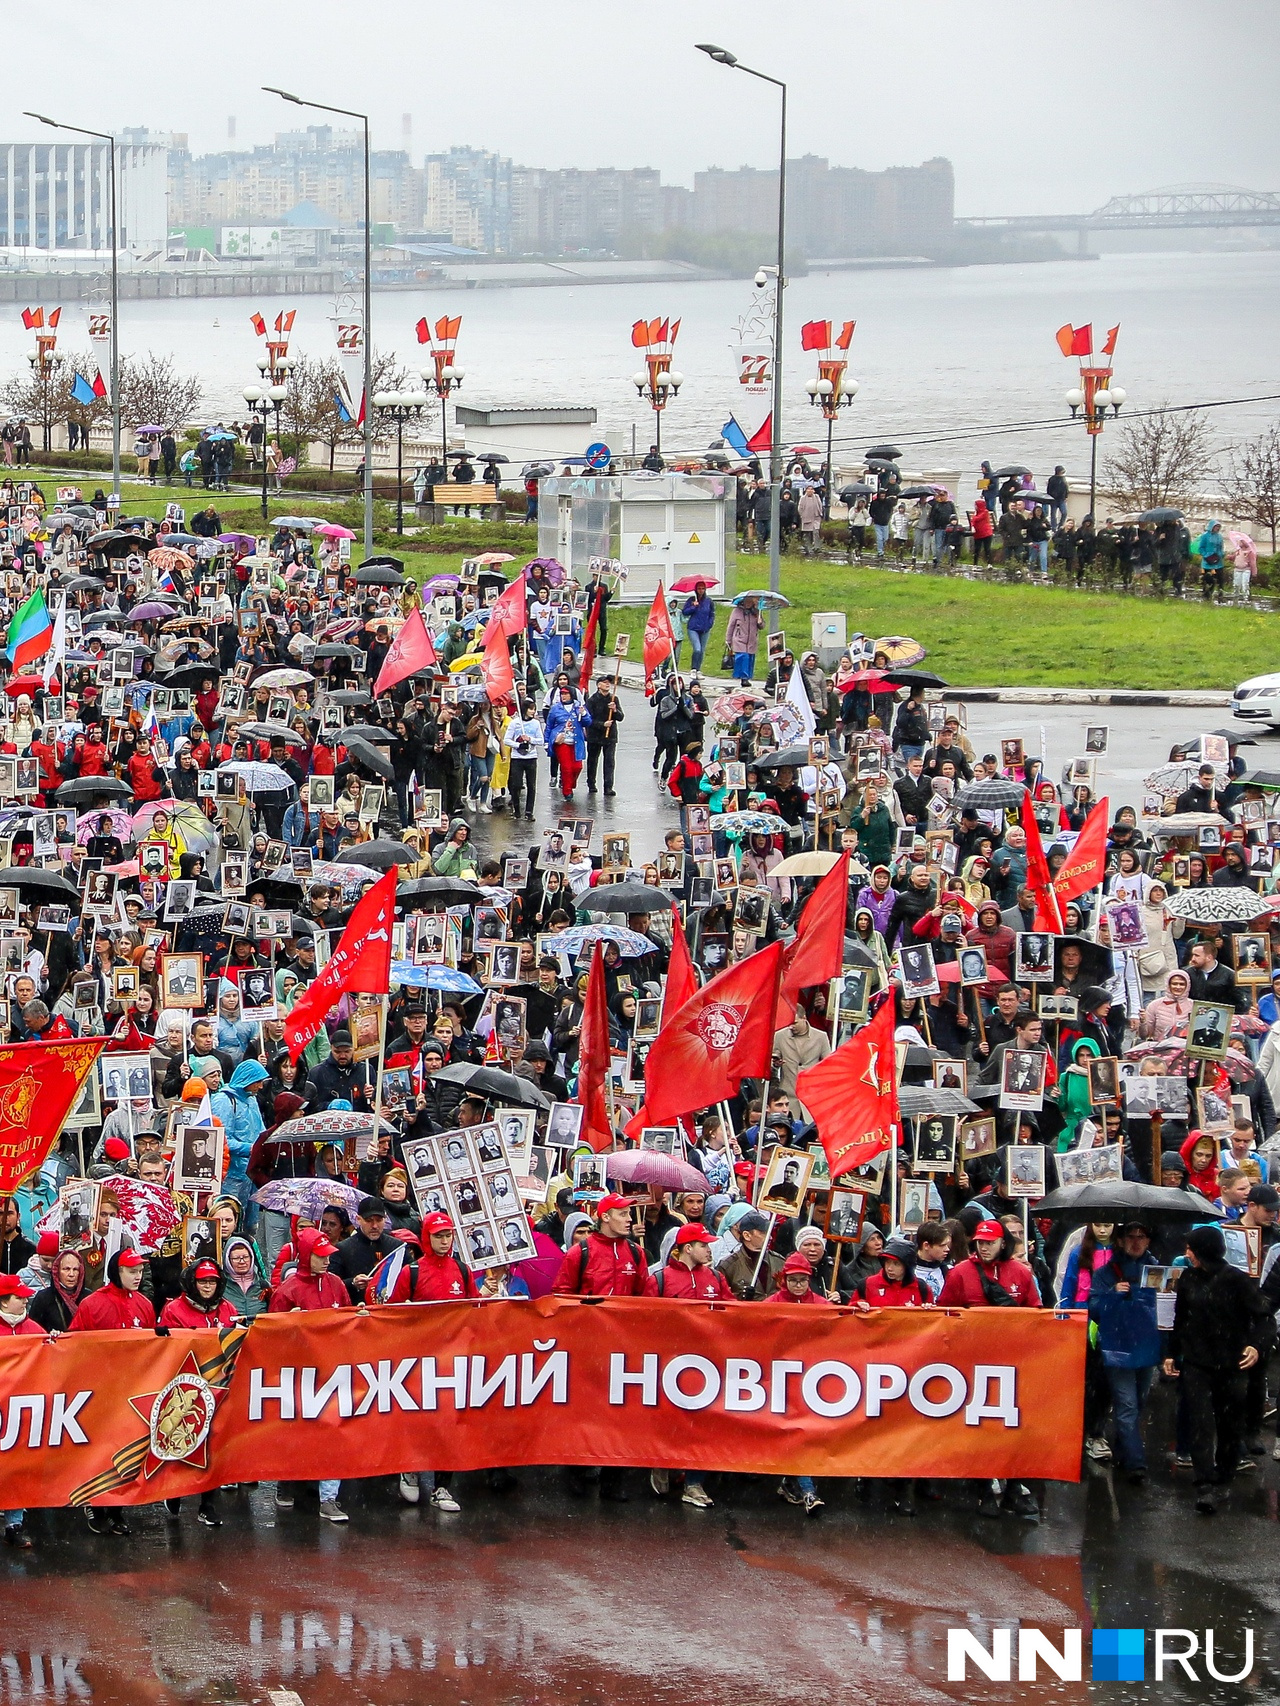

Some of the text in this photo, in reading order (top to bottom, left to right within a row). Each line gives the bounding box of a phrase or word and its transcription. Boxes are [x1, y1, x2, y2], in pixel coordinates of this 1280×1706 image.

[90, 315, 109, 335] 77
[338, 324, 361, 348] 77
[740, 355, 770, 384] 77
[247, 1337, 1020, 1428] НИЖНИЙ НОВГОРОД
